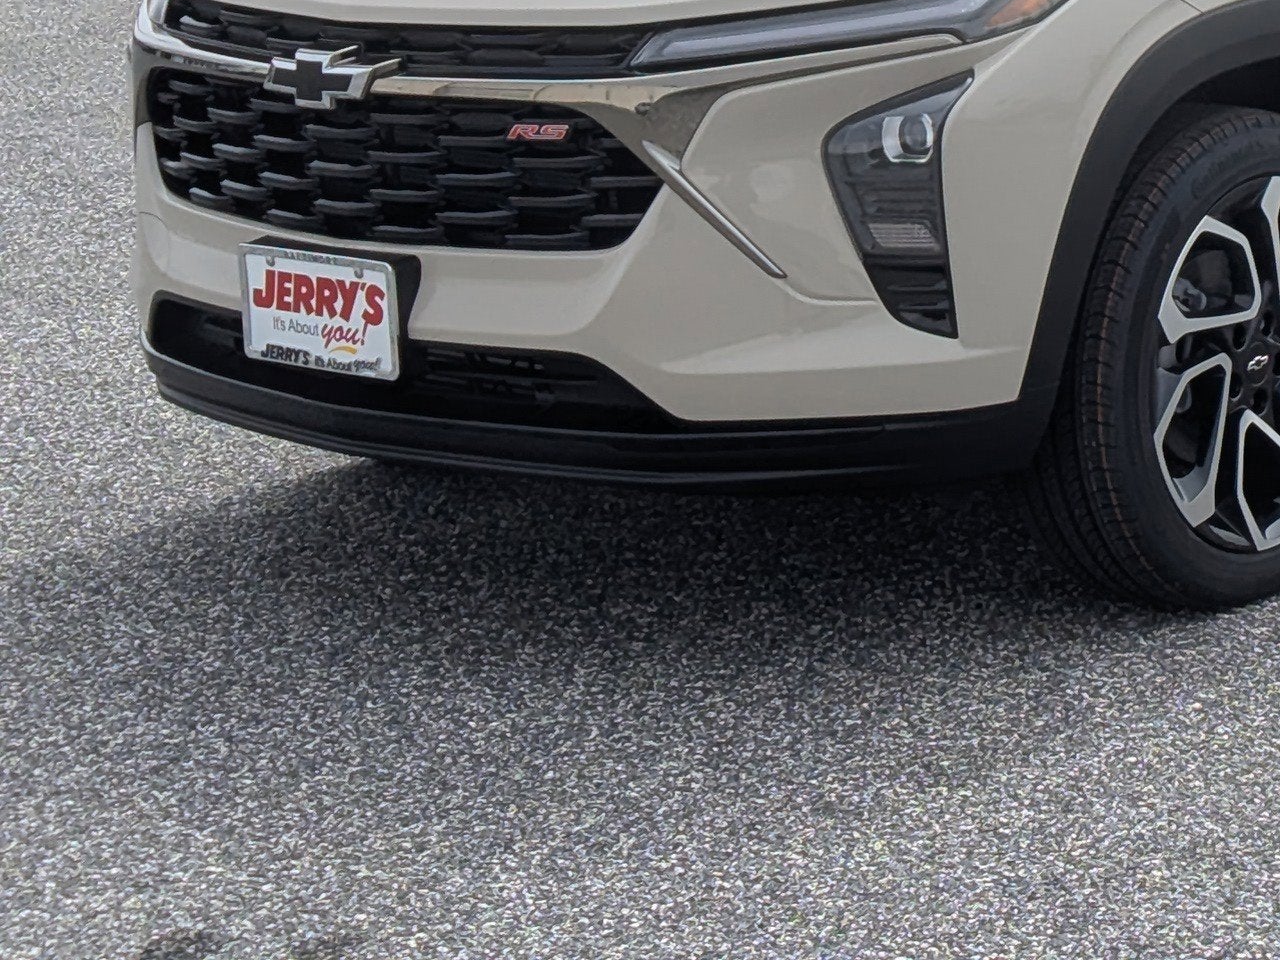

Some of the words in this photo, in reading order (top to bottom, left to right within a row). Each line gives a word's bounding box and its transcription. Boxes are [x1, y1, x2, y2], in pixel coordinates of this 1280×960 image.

[507, 124, 569, 140] RS
[252, 269, 386, 326] JERRY'S
[288, 320, 320, 336] About
[320, 321, 369, 349] you!
[261, 343, 310, 366] JERRY'S
